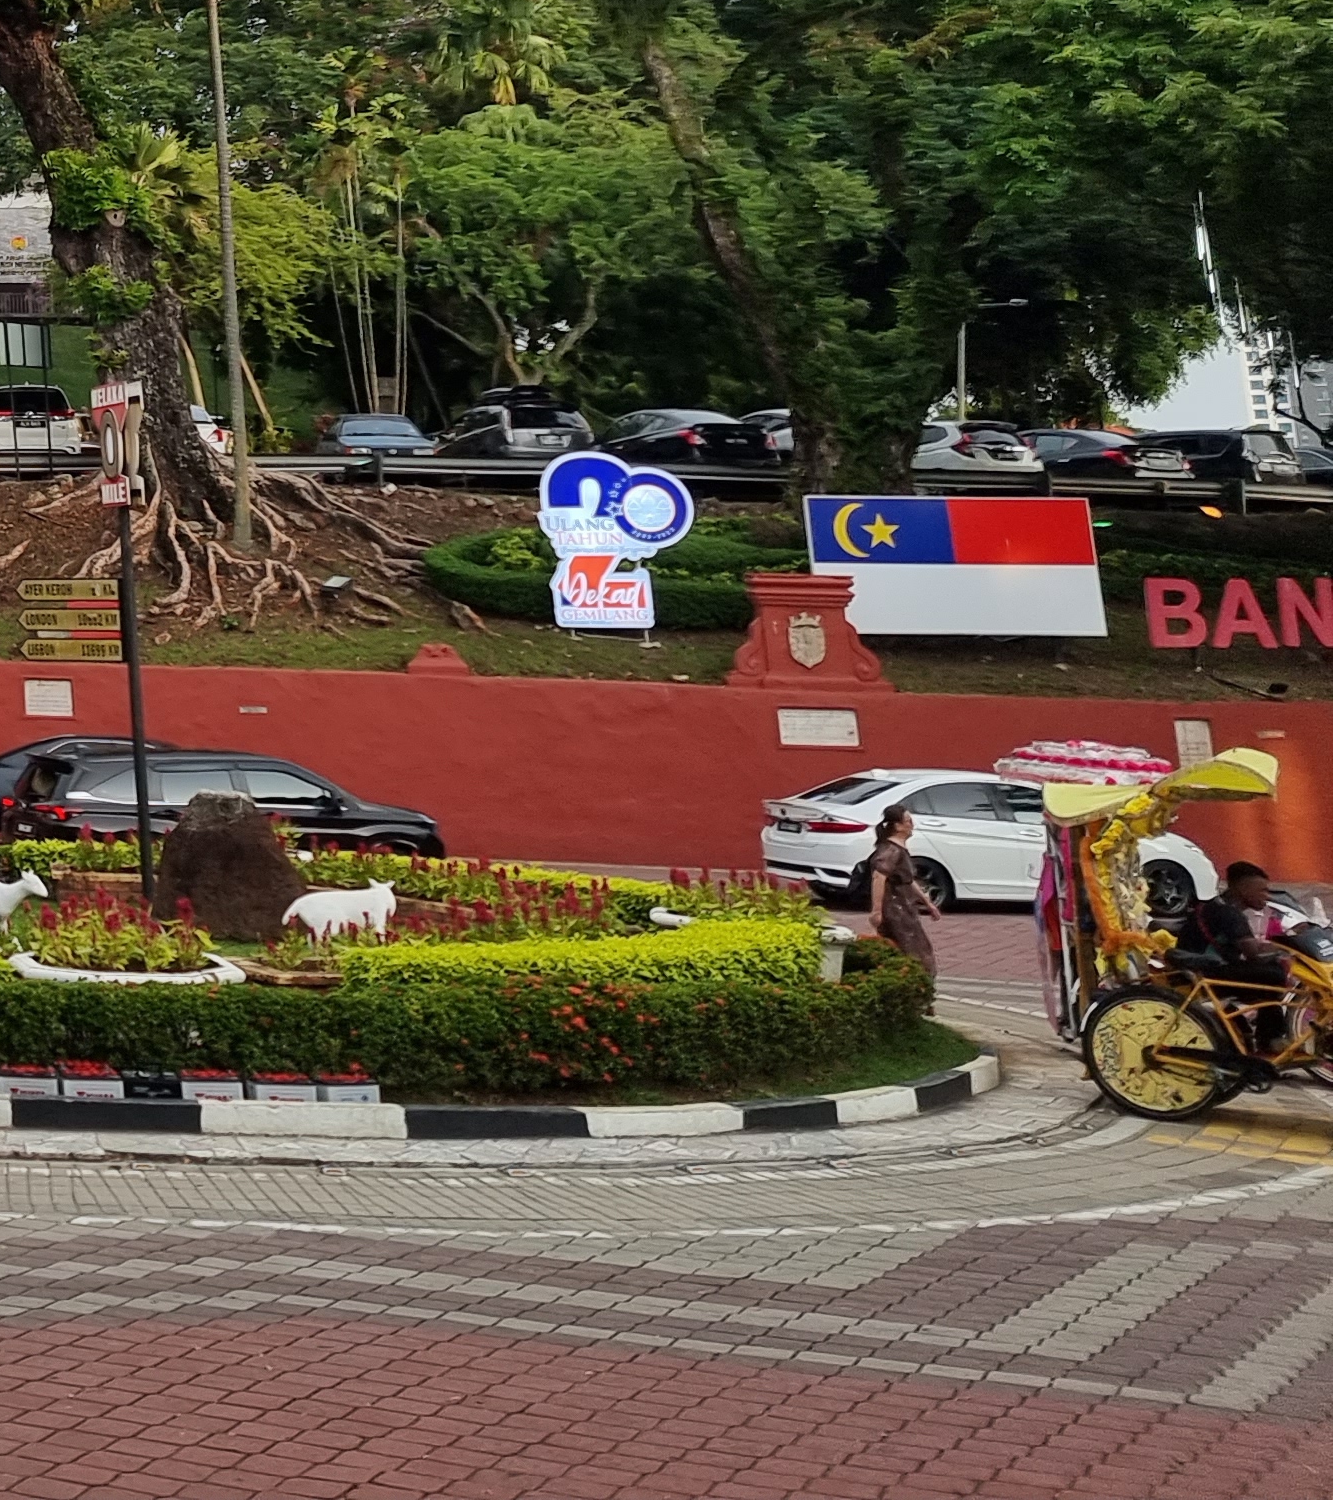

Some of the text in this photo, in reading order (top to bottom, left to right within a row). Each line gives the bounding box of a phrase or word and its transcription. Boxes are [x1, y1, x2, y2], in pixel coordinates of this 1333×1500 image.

[91, 384, 125, 409] MELAKA
[101, 482, 127, 505] MILE
[544, 515, 615, 532] ULANG
[555, 531, 623, 546] TAHUN
[24, 583, 43, 596] AYER
[25, 613, 58, 626] LONDON
[105, 613, 118, 625] KM
[561, 609, 648, 621] GEMILANG
[1145, 577, 1333, 649] BAN
[27, 643, 55, 656] LISBON
[108, 644, 120, 656] KM
